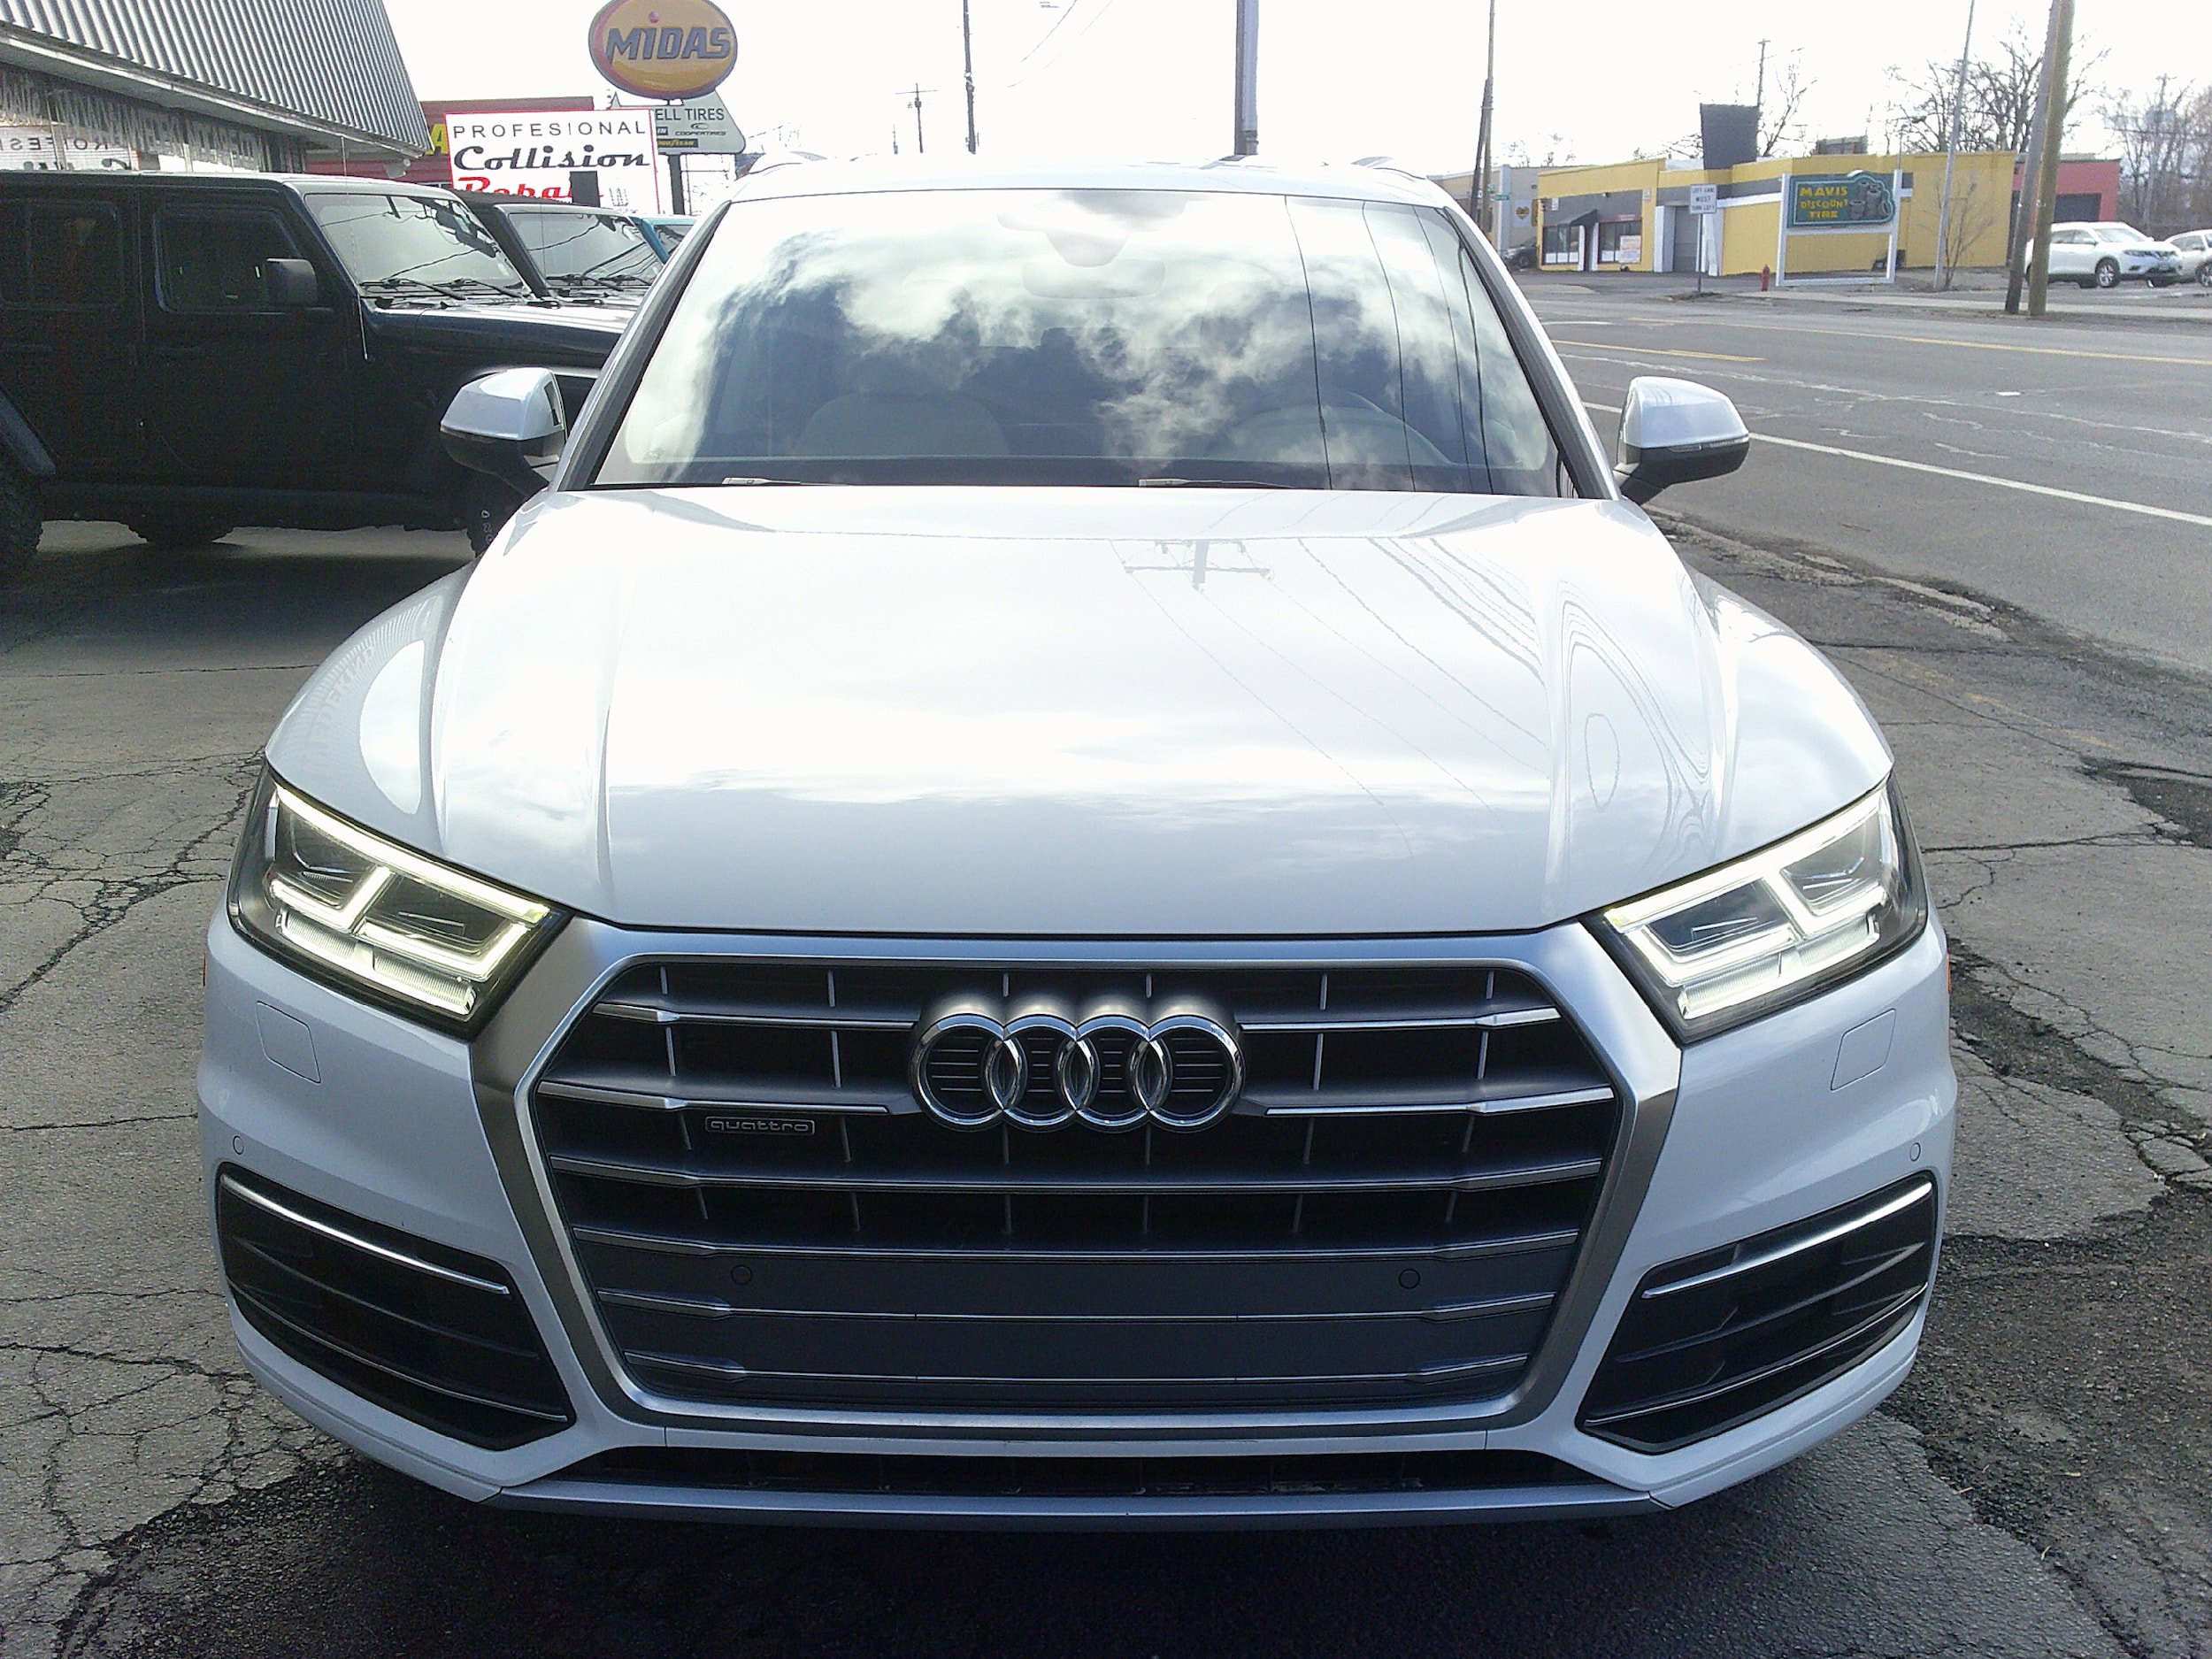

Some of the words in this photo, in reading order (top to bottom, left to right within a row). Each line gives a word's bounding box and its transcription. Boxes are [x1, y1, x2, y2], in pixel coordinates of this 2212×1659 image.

[606, 27, 731, 64] MIDAS
[656, 108, 681, 120] ELL
[685, 108, 725, 120] TIRES
[453, 120, 646, 138] PROFESIONAL
[454, 144, 650, 170] Collision
[1800, 186, 1847, 196] MAVIS
[1800, 198, 1848, 209] DISCOUNT
[710, 1120, 810, 1132] quattro
